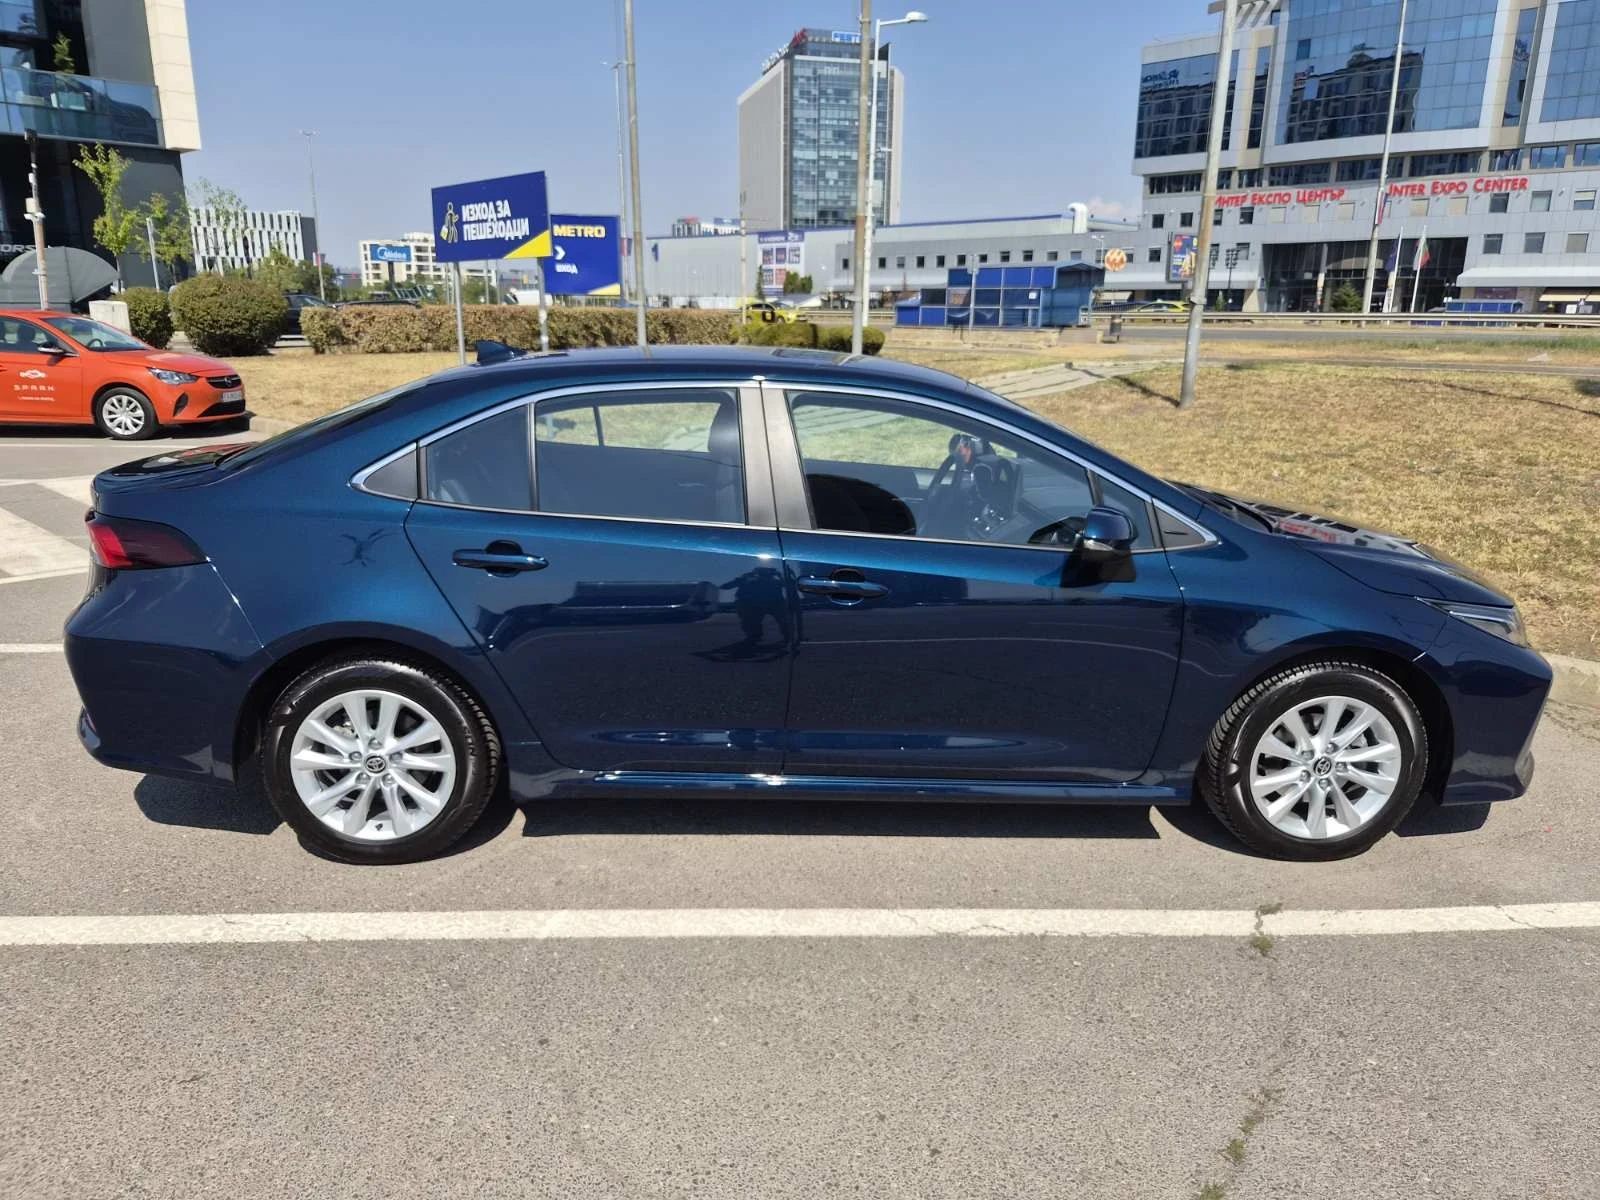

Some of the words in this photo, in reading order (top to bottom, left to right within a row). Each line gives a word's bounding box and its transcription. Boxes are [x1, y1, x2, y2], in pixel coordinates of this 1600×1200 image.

[833, 32, 860, 42] FEST
[1388, 182, 1426, 197] INTER
[1431, 180, 1468, 195] EXPO
[1473, 176, 1529, 193] CENTER
[1251, 191, 1291, 206] ЕКСПО
[1296, 188, 1345, 204] ЦЕНТЪР
[461, 201, 497, 222] ИЗХОД
[495, 199, 512, 218] ЗА
[462, 217, 530, 241] ПЕШЕХОДЦИ
[552, 223, 606, 239] METRO
